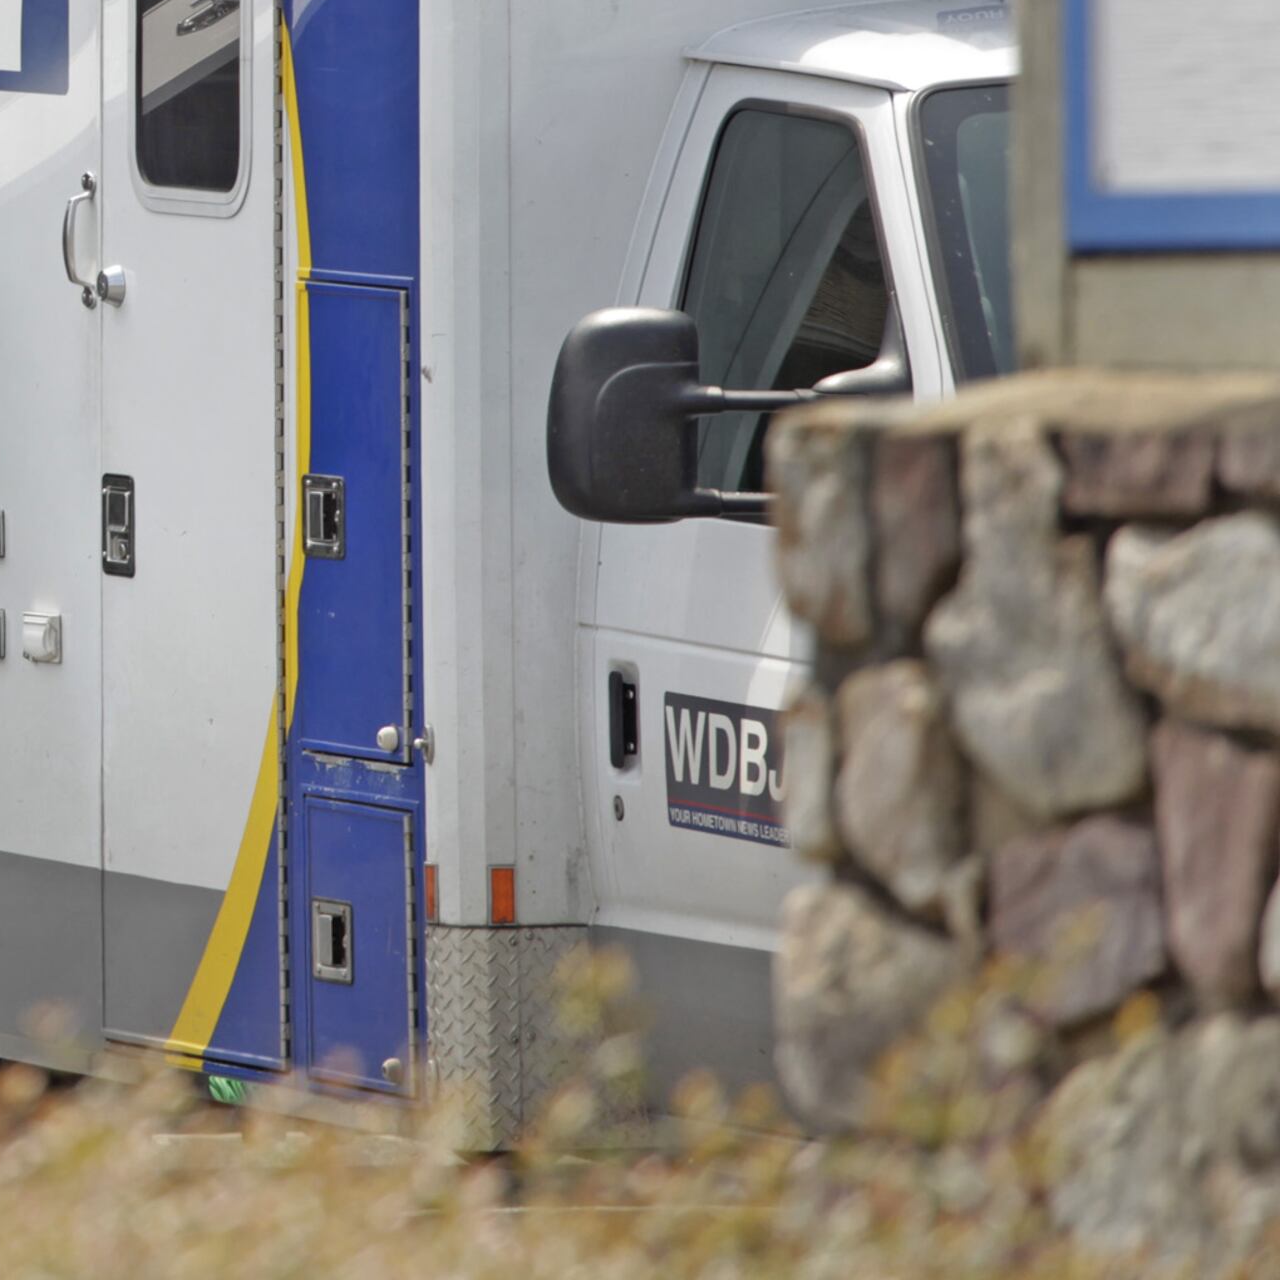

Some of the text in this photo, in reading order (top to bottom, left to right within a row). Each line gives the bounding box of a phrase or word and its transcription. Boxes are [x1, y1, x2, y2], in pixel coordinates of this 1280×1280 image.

[665, 704, 790, 803] WDBJ
[669, 807, 691, 823] YOUR
[692, 811, 737, 833] HOMETOWN
[738, 820, 760, 838] NEWS
